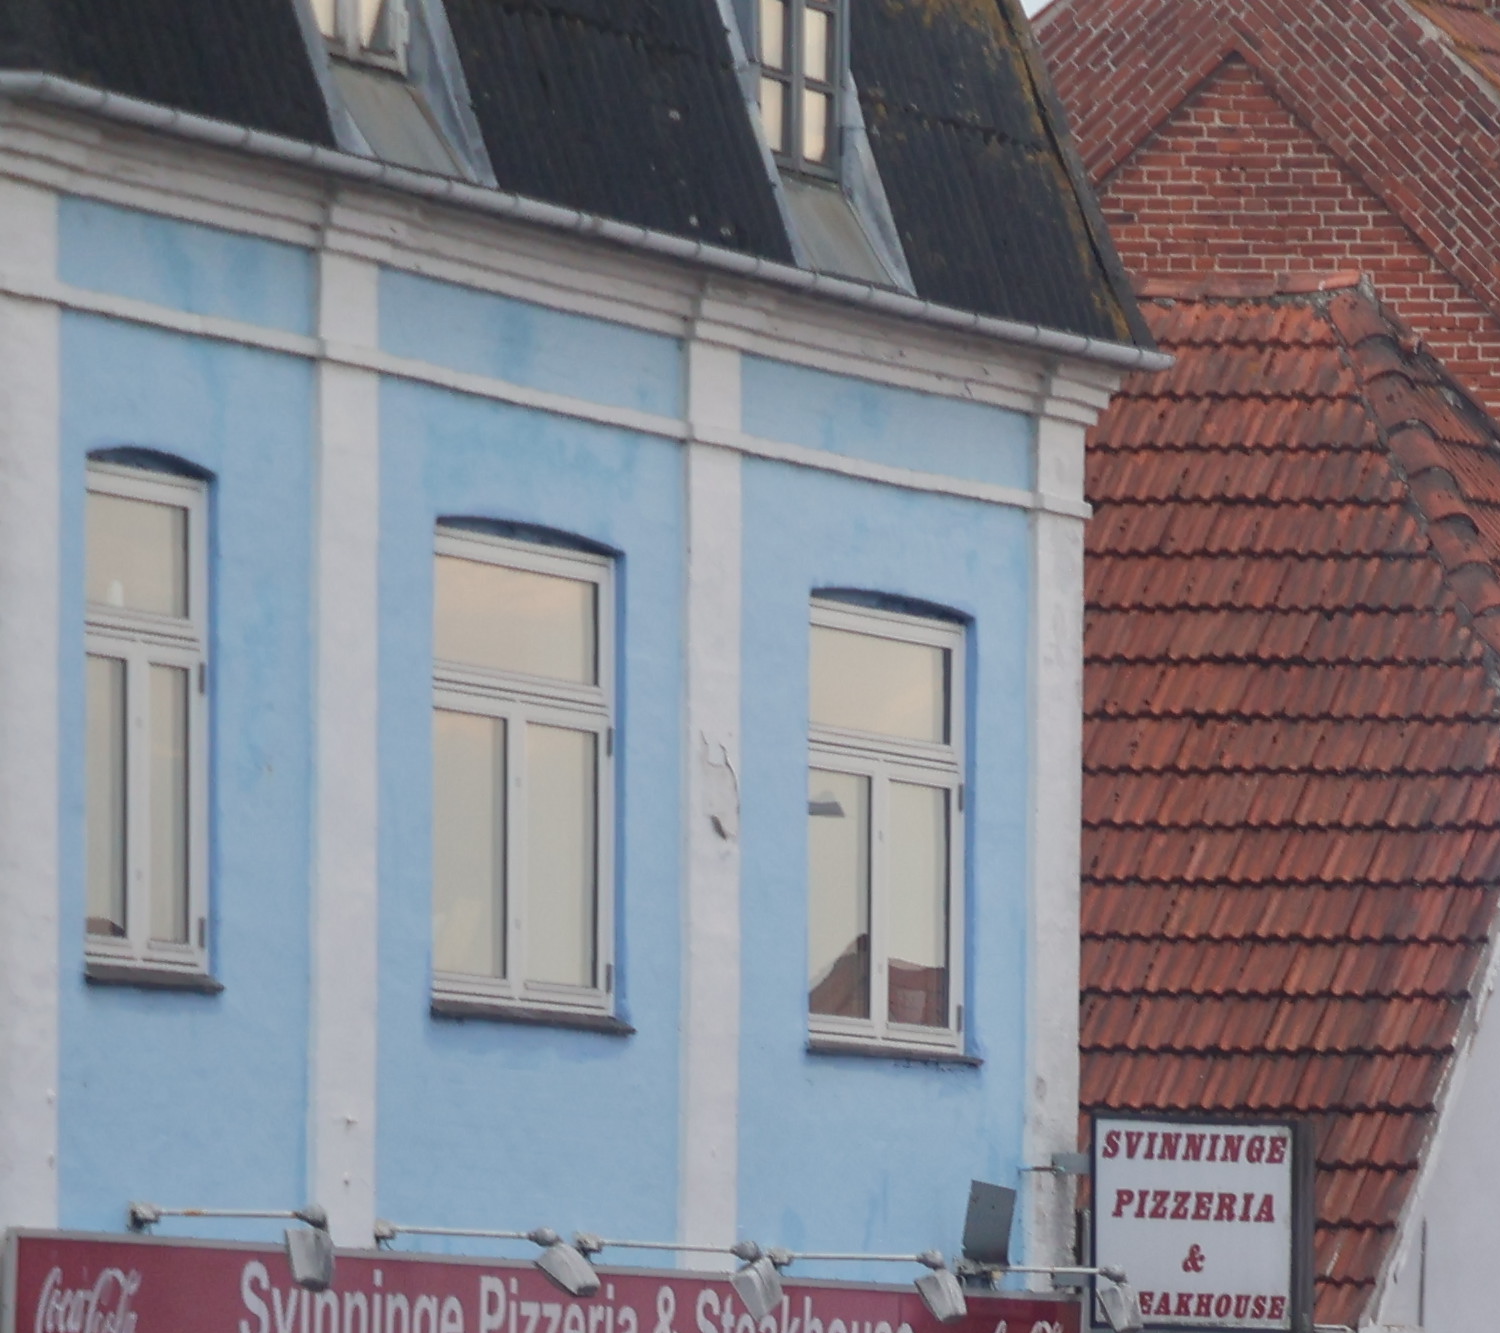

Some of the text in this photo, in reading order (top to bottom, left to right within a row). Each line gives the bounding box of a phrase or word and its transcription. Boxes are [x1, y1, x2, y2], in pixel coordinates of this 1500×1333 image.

[1102, 1130, 1287, 1164] SVINNINGE
[1112, 1189, 1275, 1222] PIZZERIA
[1182, 1244, 1205, 1272] &
[1139, 1291, 1286, 1320] EAKHOUSE
